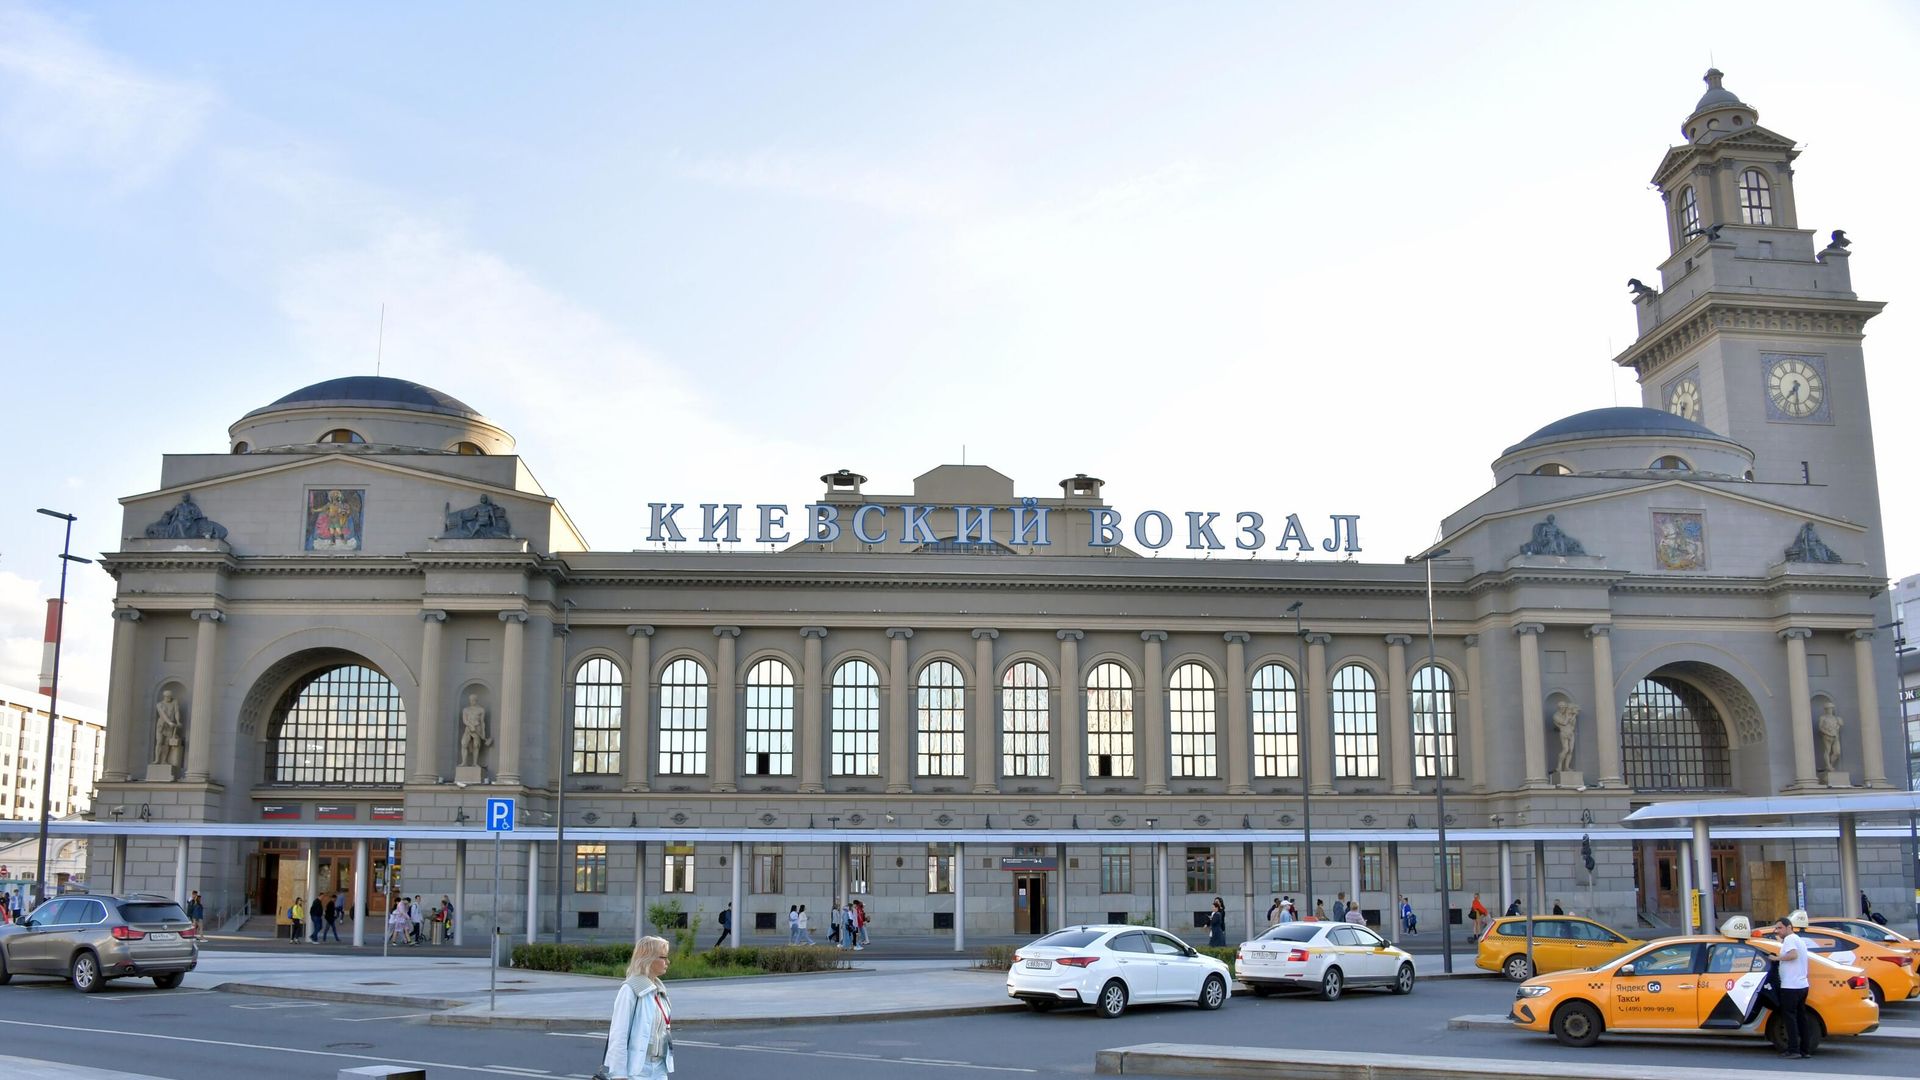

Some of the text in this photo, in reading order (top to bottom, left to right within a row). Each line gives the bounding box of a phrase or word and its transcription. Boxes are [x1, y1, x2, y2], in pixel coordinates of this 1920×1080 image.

[646, 497, 1363, 552] КИЕВСКИЙ ВОКЗАЛ
[493, 802, 508, 828] P
[1616, 983, 1660, 992] Яндекс Go
[1617, 995, 1640, 1003] Такси
